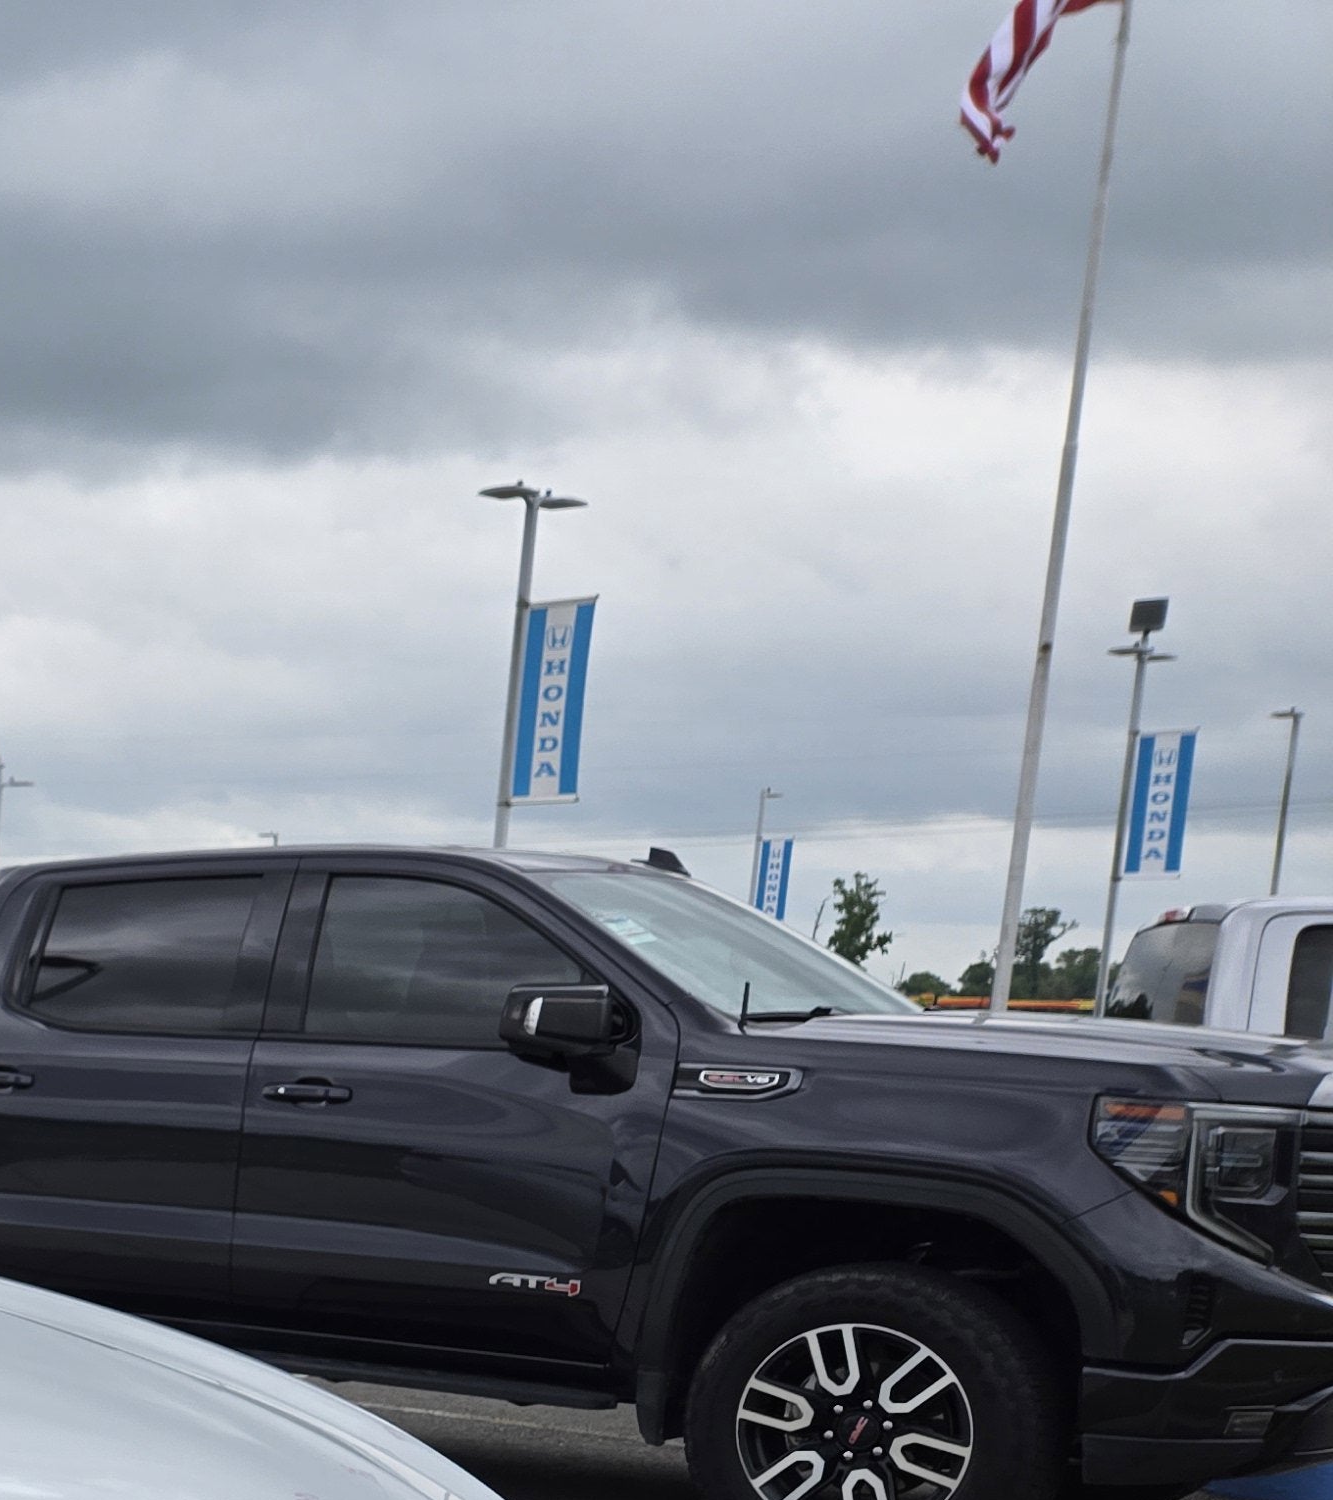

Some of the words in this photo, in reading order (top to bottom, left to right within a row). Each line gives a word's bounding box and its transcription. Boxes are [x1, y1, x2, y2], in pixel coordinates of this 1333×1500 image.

[534, 657, 566, 778] HONDA
[1144, 772, 1173, 860] HONDA
[488, 1272, 581, 1297] AT4
